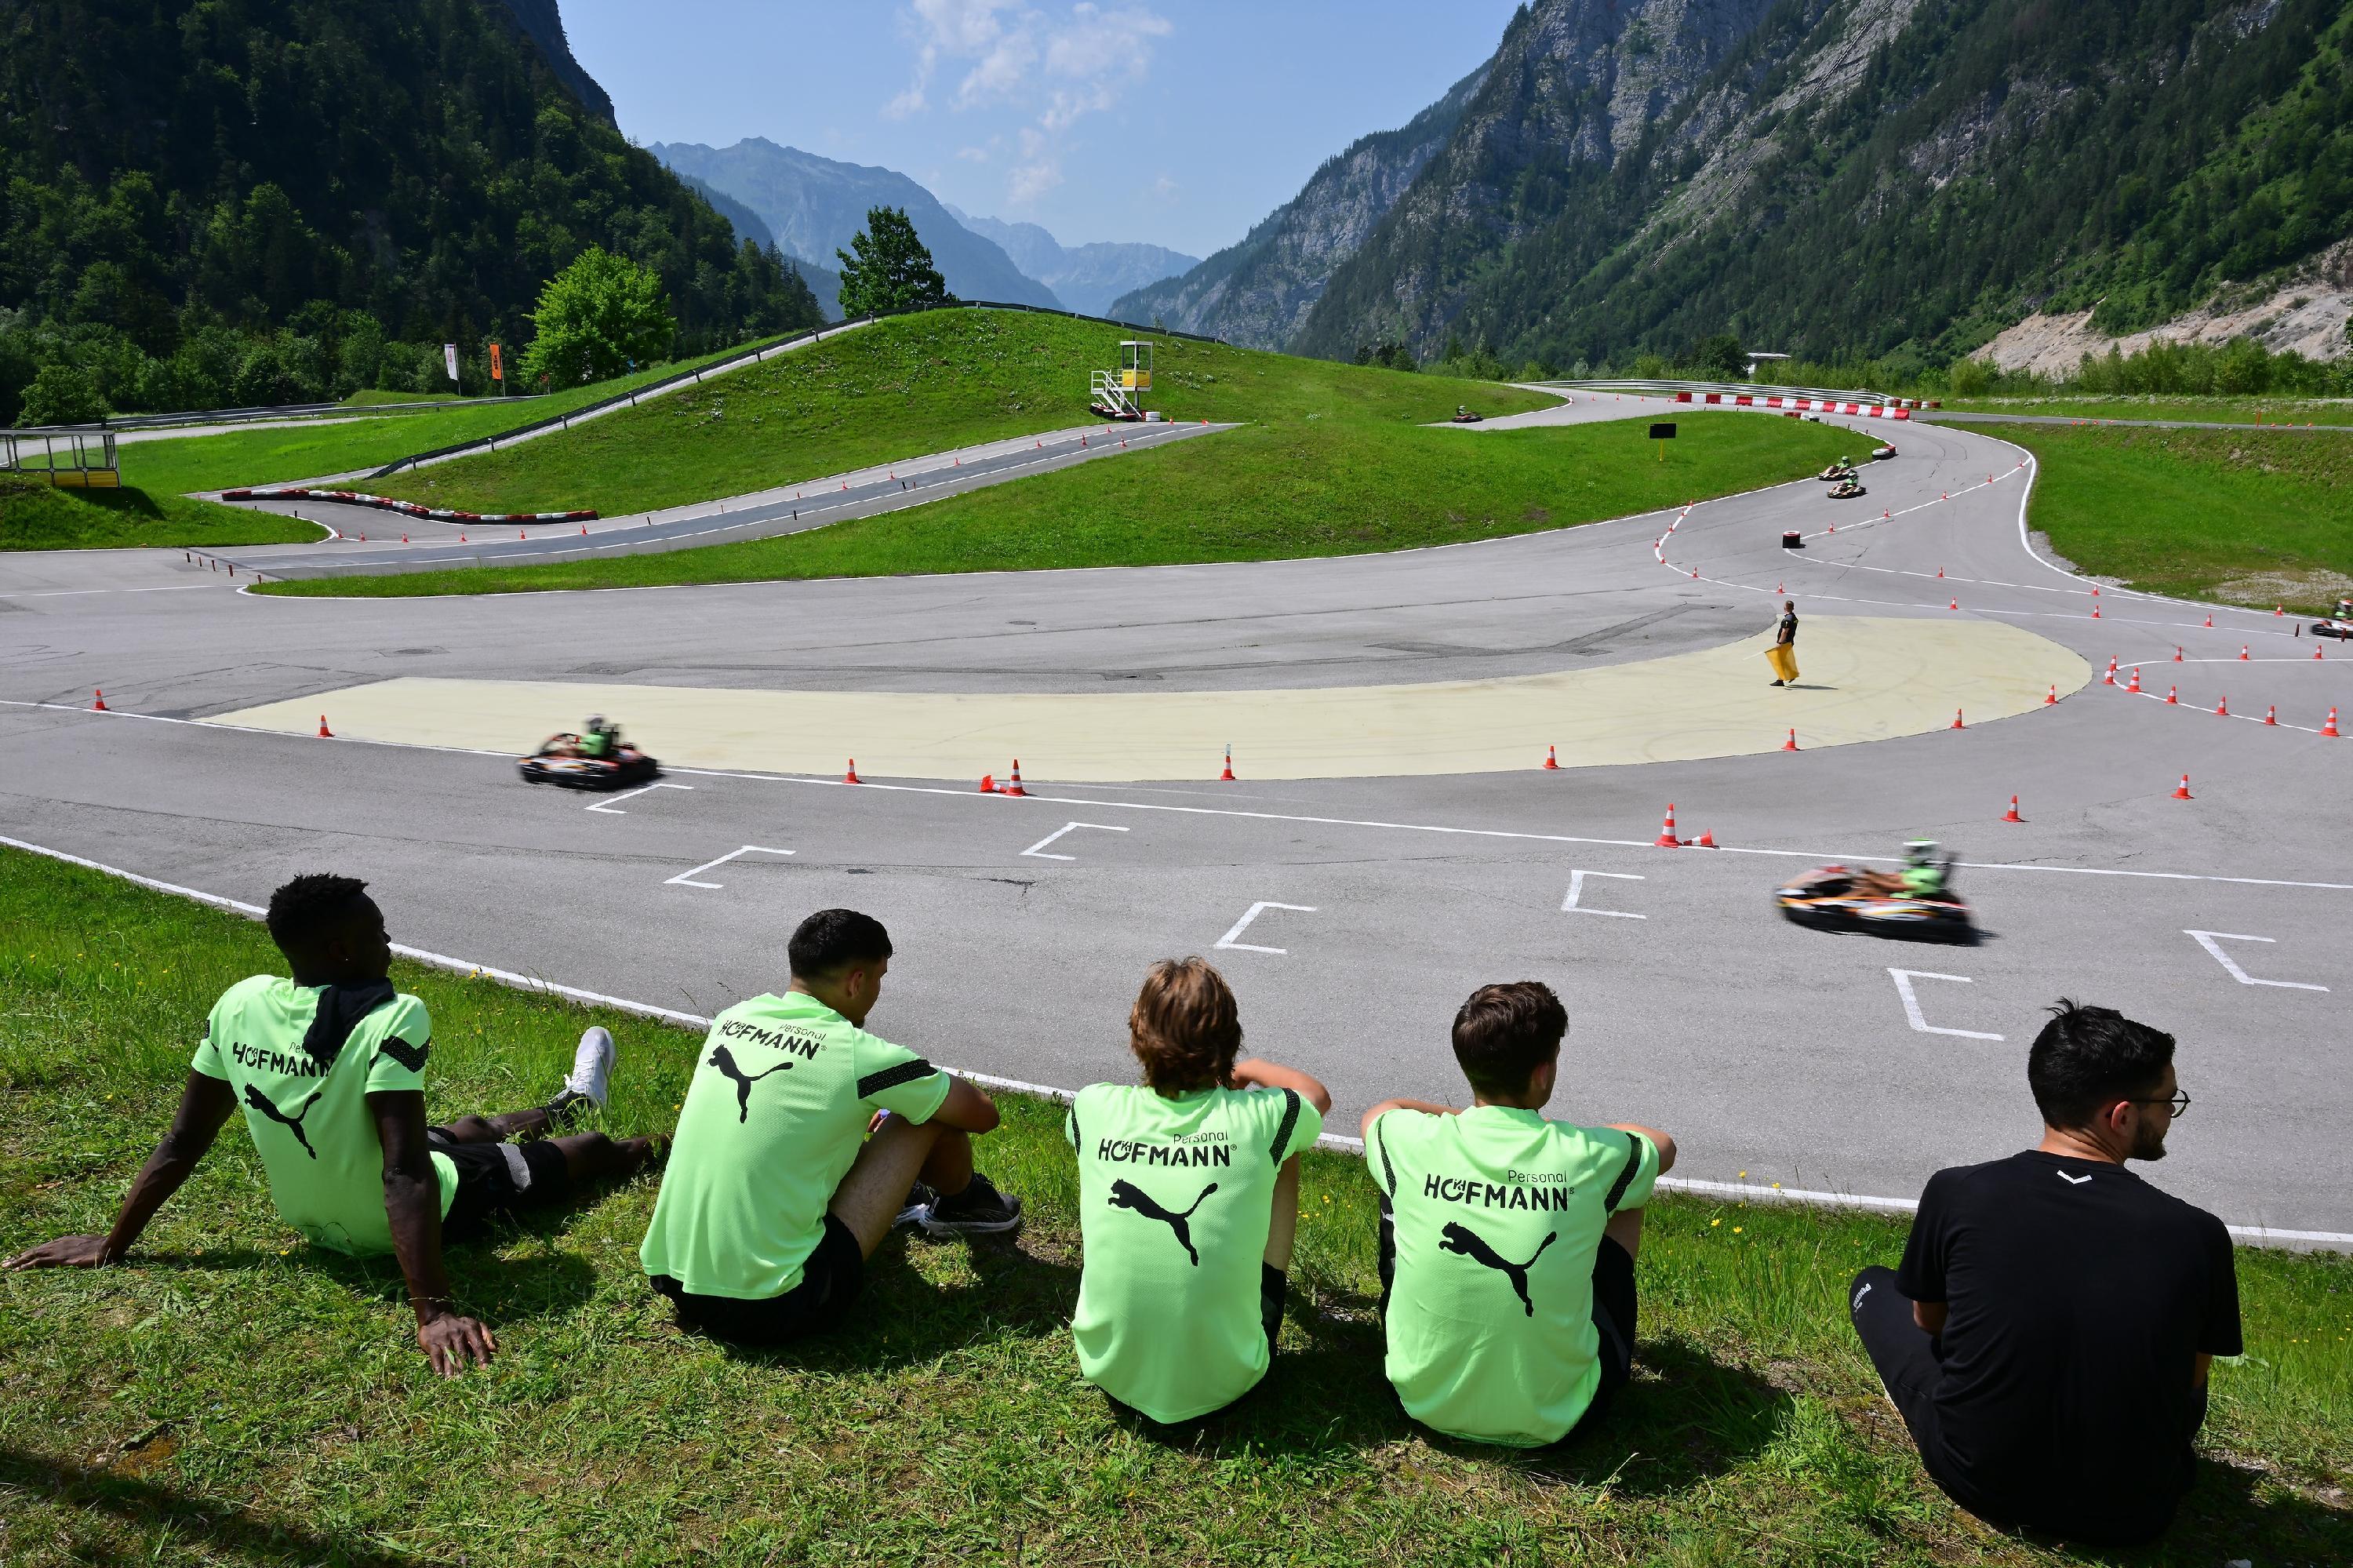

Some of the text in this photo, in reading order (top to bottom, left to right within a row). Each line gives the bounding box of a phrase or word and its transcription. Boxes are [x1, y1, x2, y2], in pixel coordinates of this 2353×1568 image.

[778, 1024, 827, 1041] Personal
[1173, 1130, 1229, 1144] Personal
[1098, 1138, 1231, 1167] HOFMANN
[1507, 1170, 1567, 1183] Personal
[1424, 1173, 1568, 1212] HOFMANN
